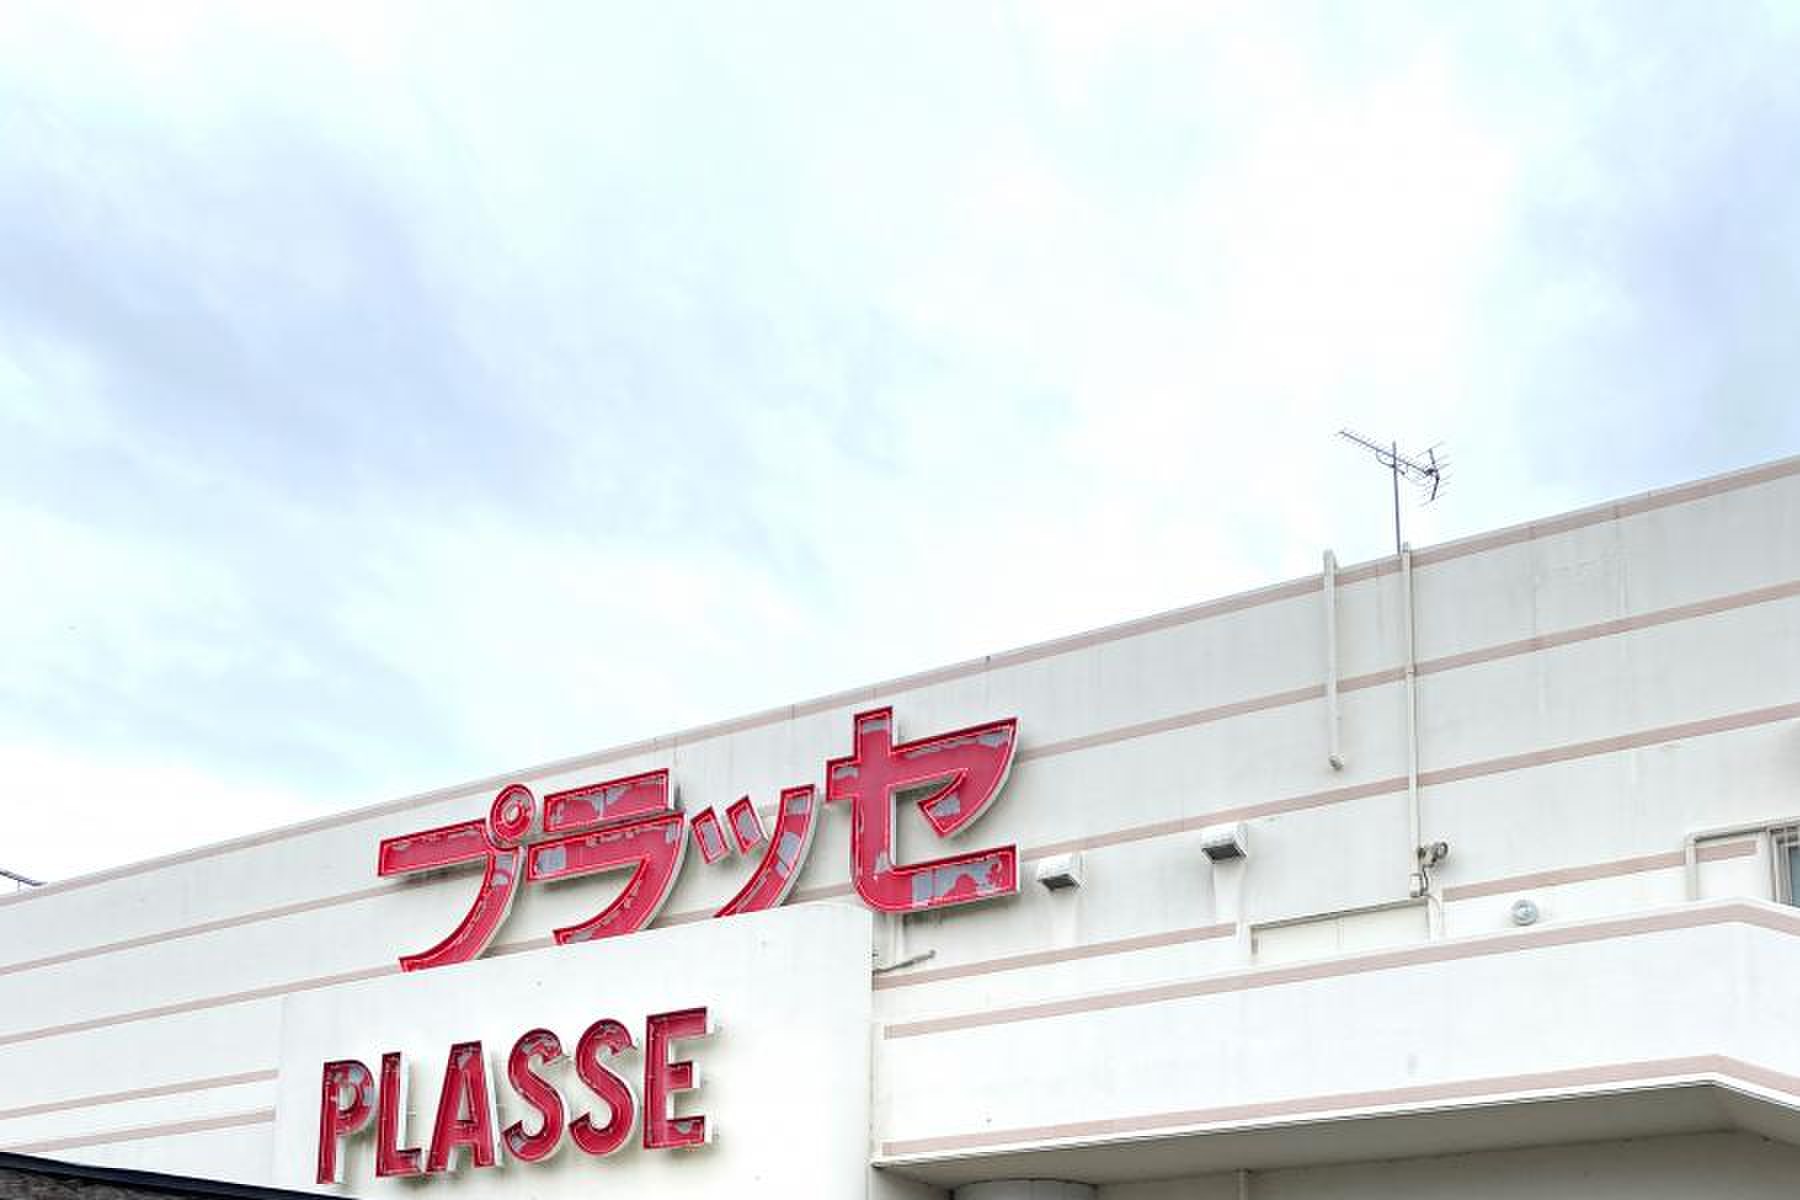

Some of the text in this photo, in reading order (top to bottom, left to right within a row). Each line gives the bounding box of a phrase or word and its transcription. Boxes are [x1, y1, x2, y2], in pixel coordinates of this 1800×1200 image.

[378, 706, 1019, 971] プラッセ
[316, 1006, 713, 1185] PLASSE
